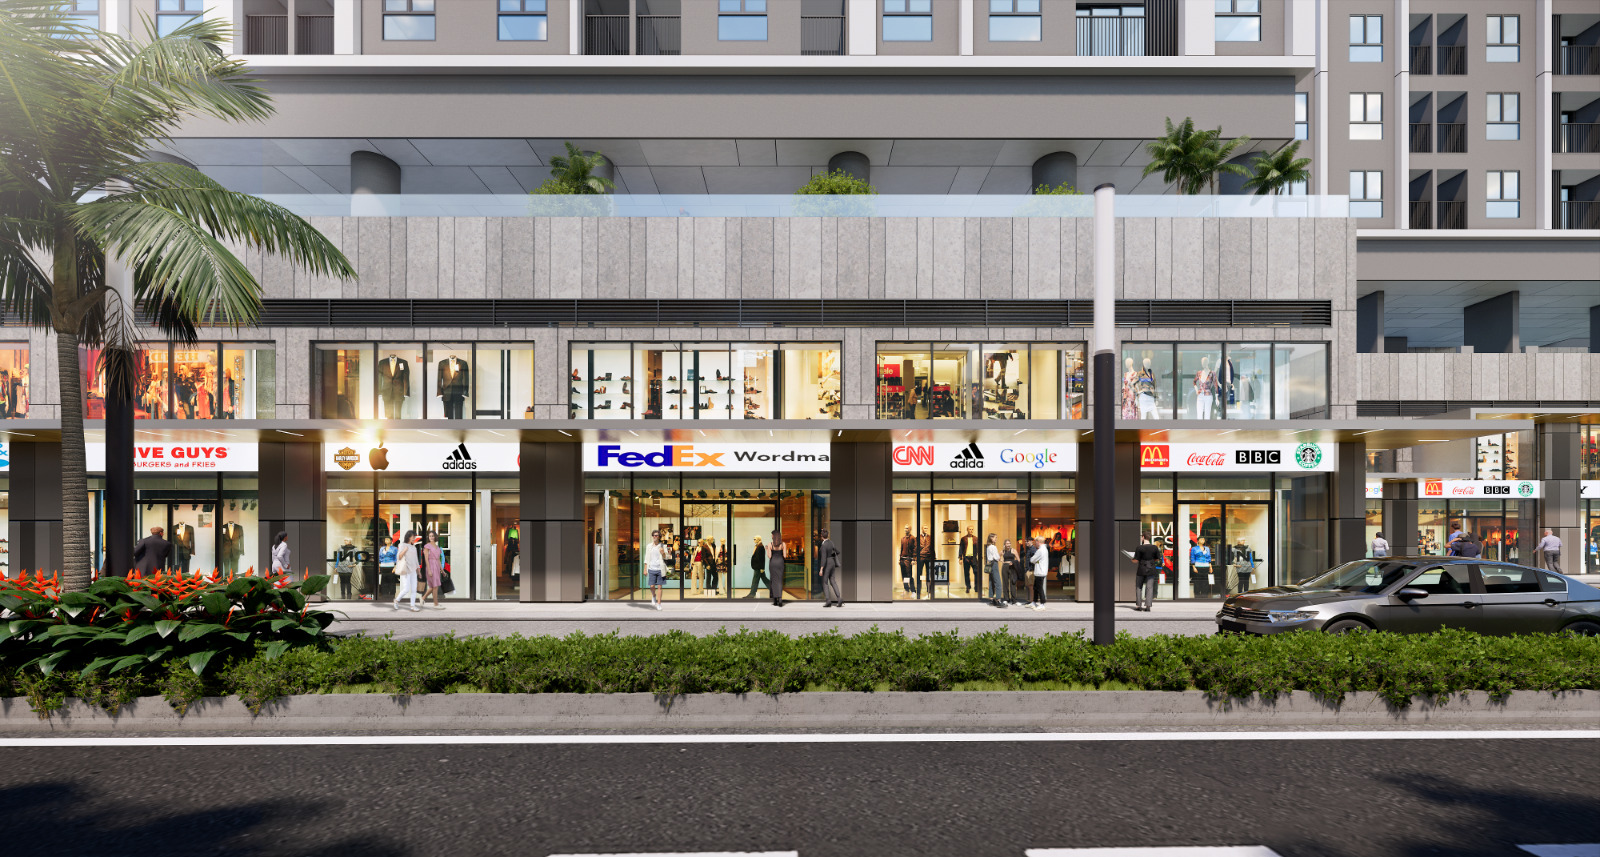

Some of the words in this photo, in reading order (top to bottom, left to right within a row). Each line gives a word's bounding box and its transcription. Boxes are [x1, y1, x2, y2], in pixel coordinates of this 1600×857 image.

[133, 446, 164, 459] IVE
[170, 446, 228, 459] GUYS
[597, 444, 726, 468] FedEx
[733, 450, 830, 463] Wordma
[892, 445, 935, 466] CNN
[999, 448, 1058, 469] Google
[1238, 451, 1279, 463] BBC
[442, 459, 478, 470] adidas
[949, 458, 984, 469] adida
[1485, 486, 1509, 494] BBC
